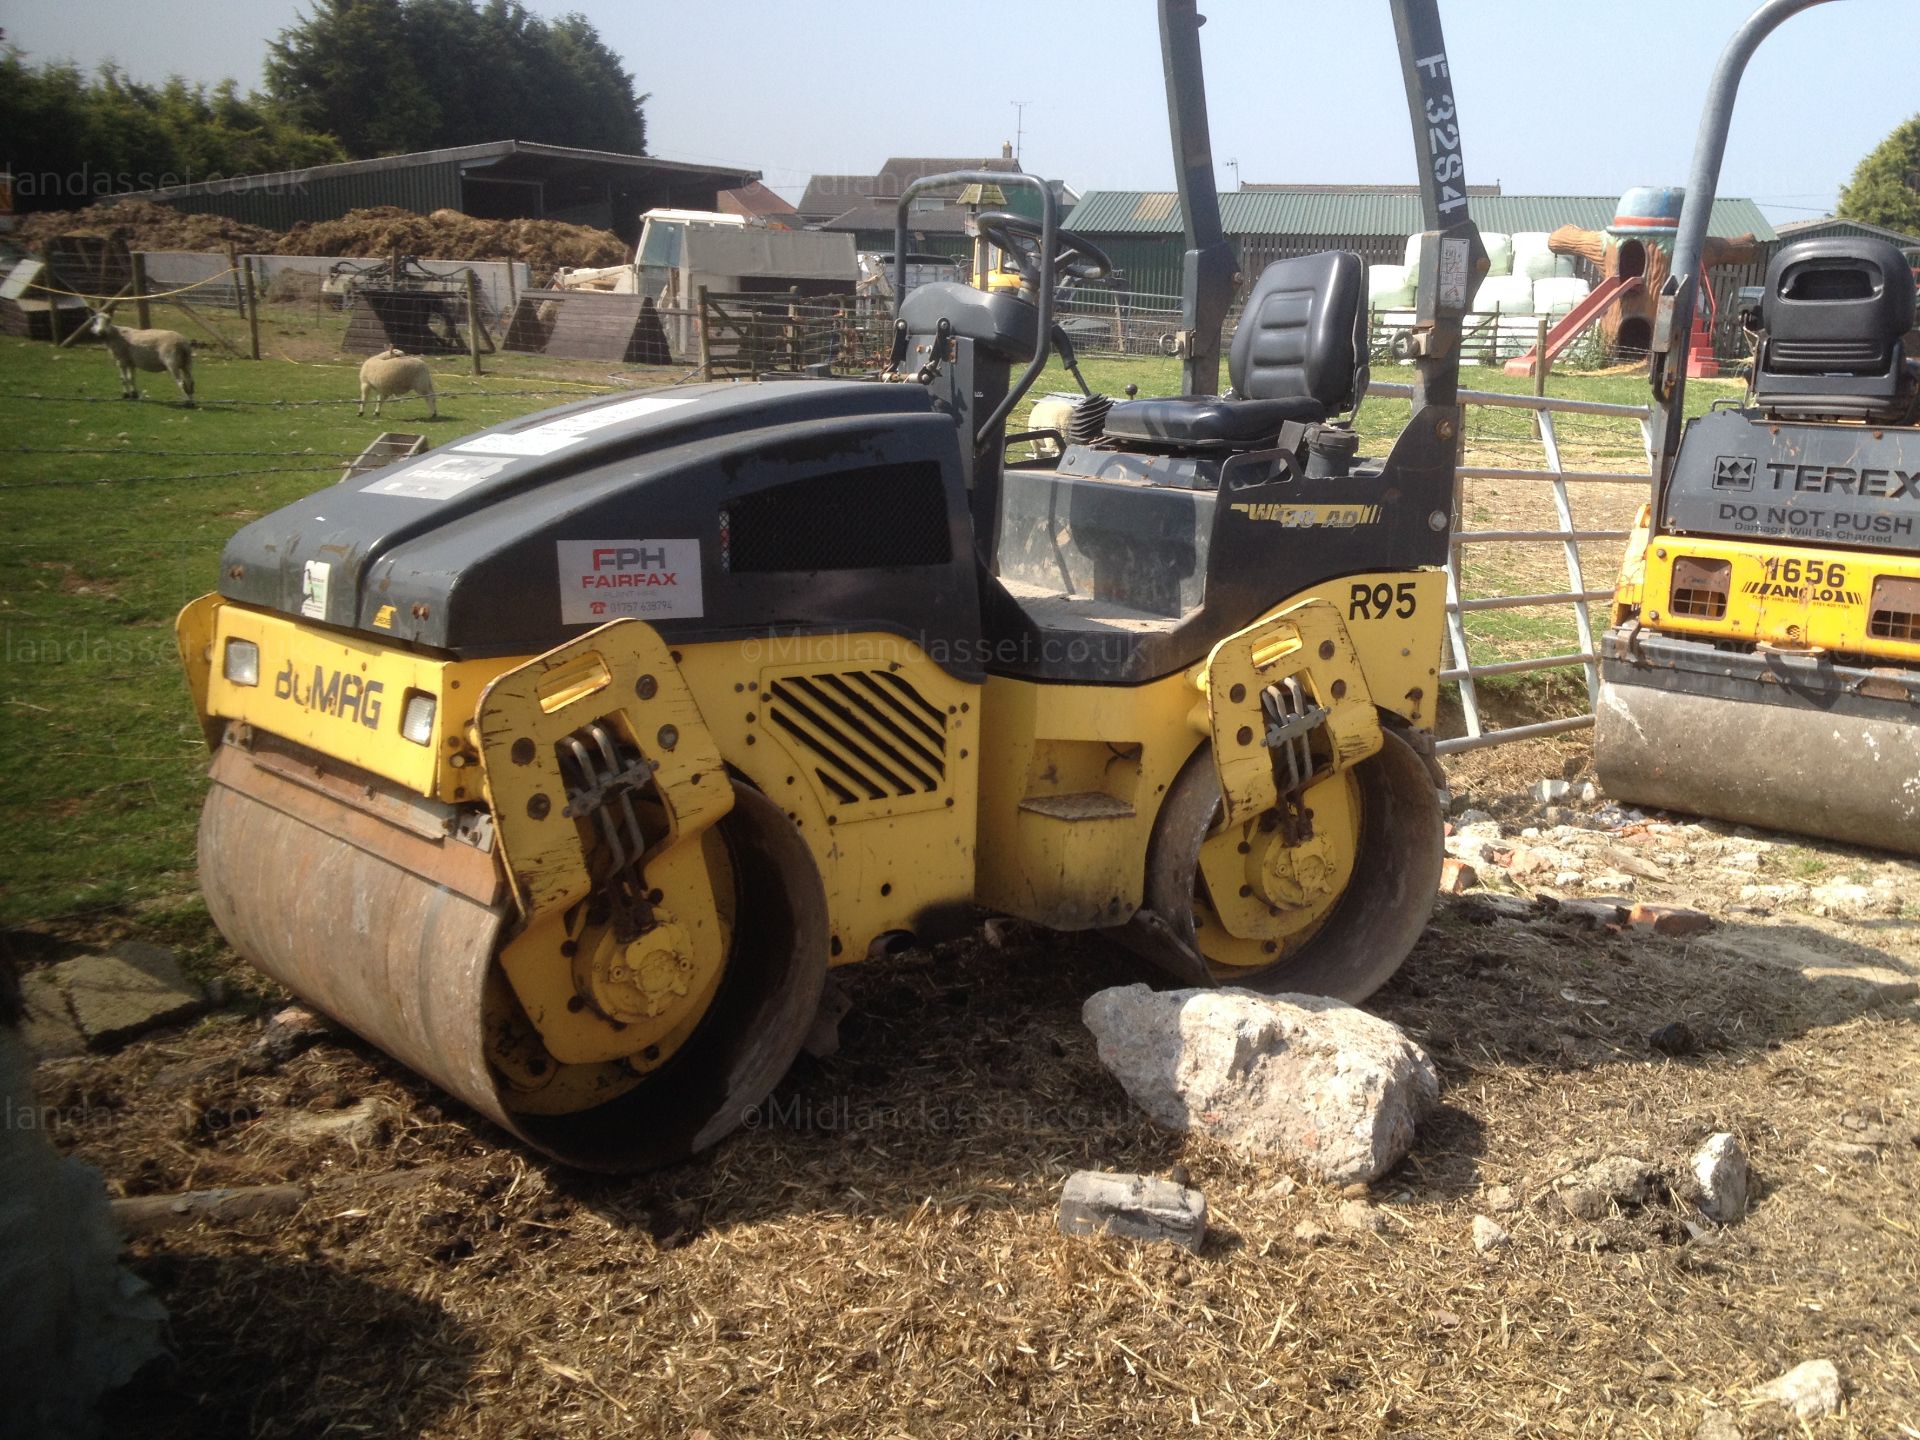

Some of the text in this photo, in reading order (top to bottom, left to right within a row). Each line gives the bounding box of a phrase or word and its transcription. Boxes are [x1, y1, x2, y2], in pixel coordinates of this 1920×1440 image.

[1416, 53, 1448, 79] F
[1766, 462, 1920, 500] TEREX
[1719, 503, 1913, 535] DO NOT PUSH
[1734, 521, 1892, 545] Damage Will Be Charged
[592, 547, 666, 571] FPH
[1765, 556, 1846, 588] 1656
[582, 572, 677, 588] FAIRFAX
[1349, 582, 1417, 621] R95
